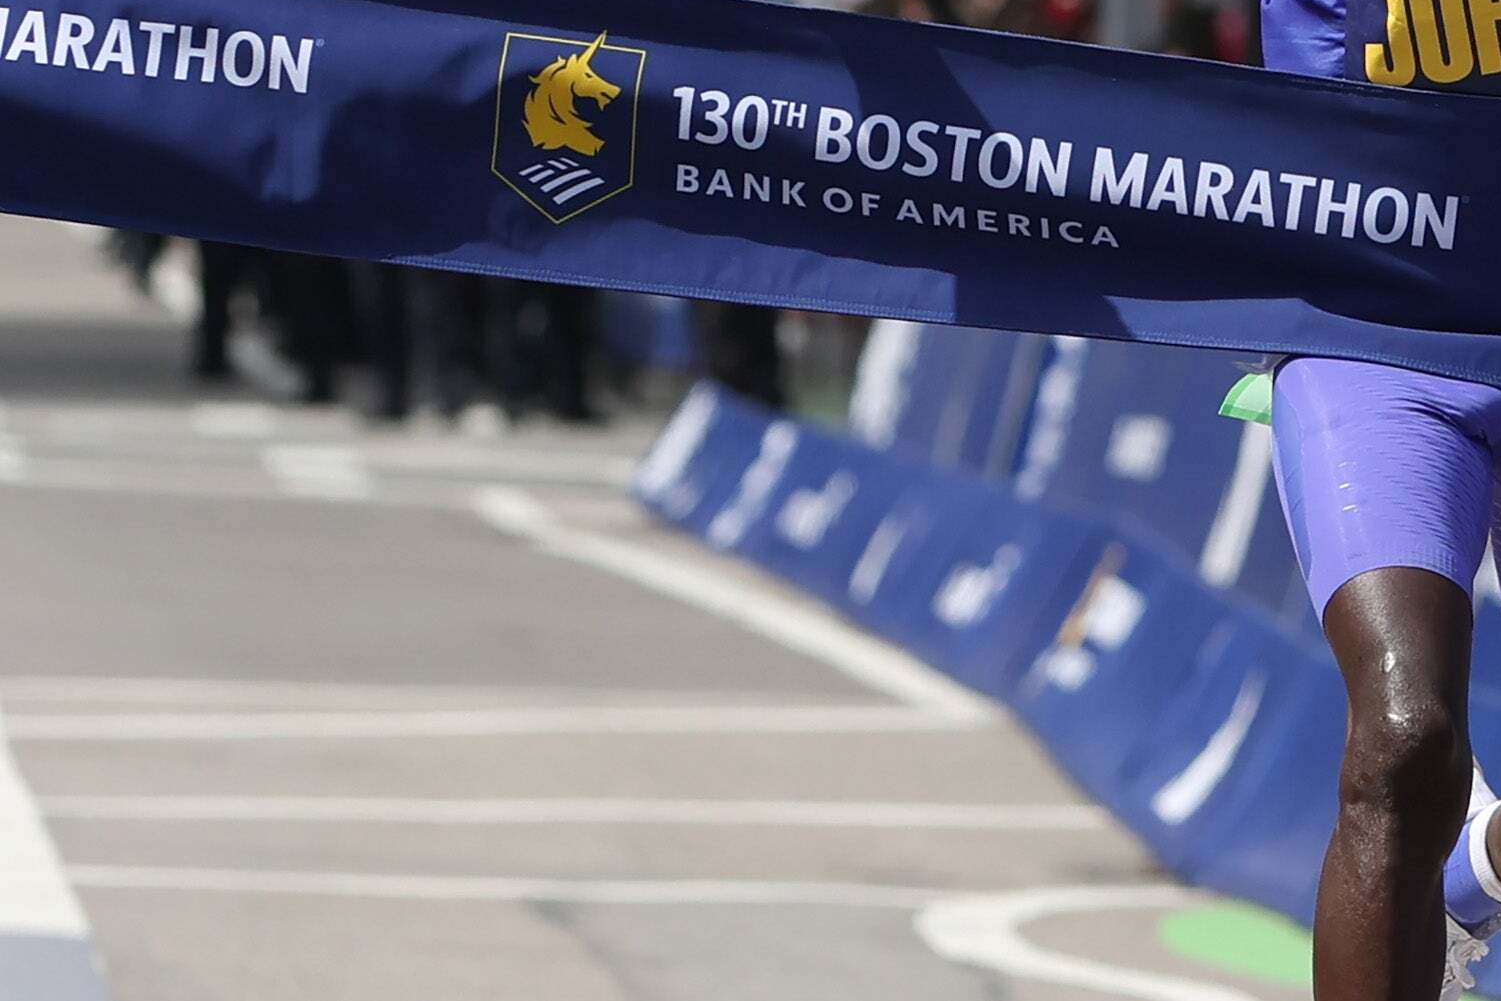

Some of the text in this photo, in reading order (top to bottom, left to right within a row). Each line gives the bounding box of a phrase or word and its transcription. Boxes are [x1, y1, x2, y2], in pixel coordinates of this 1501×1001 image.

[0, 7, 315, 94] ARATHON
[673, 86, 1460, 250] 130TH BOSTON MARATHON
[676, 164, 1119, 247] BANK OF AMERICA
